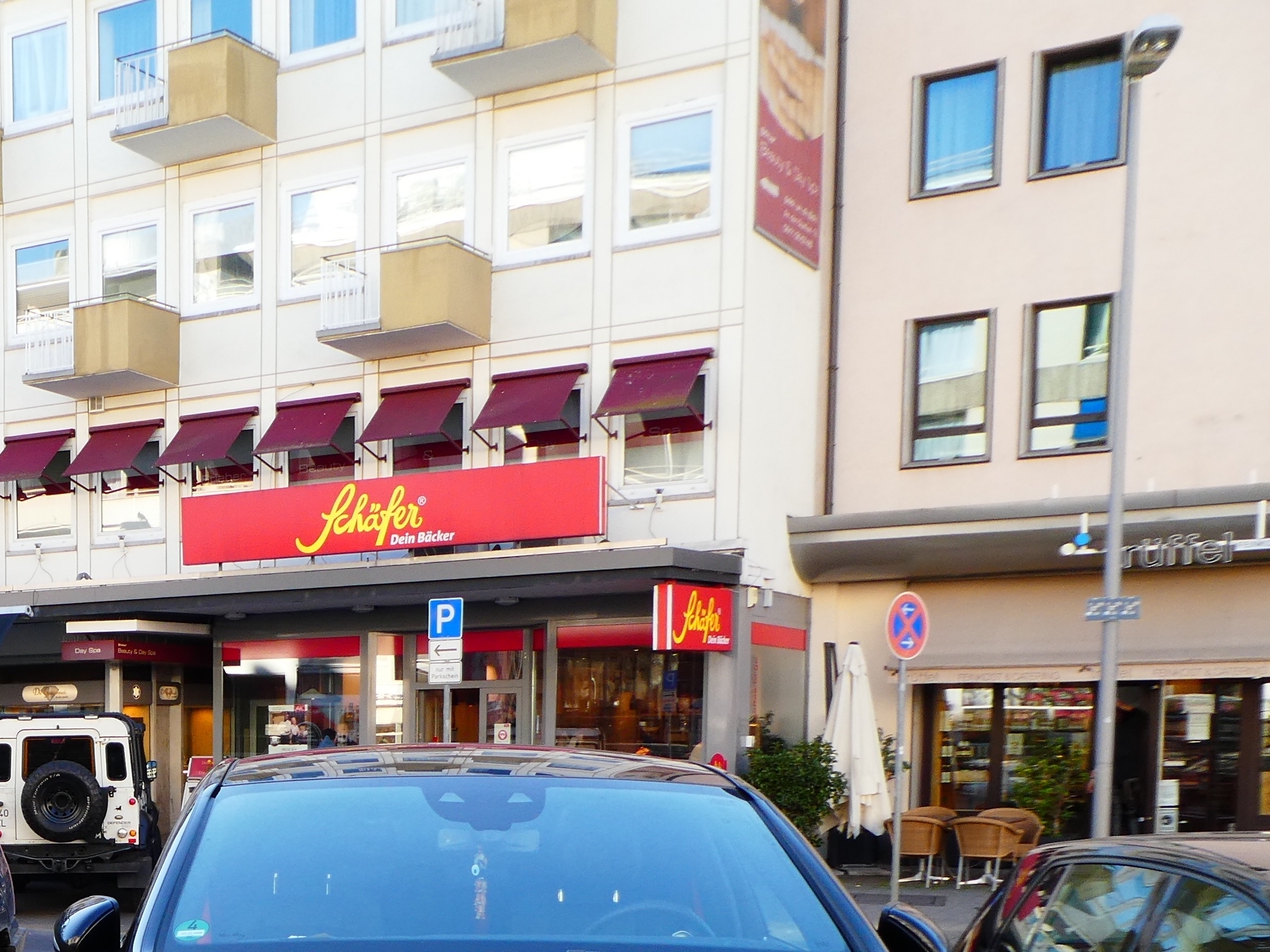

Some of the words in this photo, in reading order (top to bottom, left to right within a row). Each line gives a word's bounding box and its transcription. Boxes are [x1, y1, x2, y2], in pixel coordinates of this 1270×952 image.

[390, 532, 415, 545] Dein
[417, 530, 455, 543] Bäcker
[436, 604, 455, 634] P
[74, 647, 87, 655] Day
[88, 646, 101, 654] Spa
